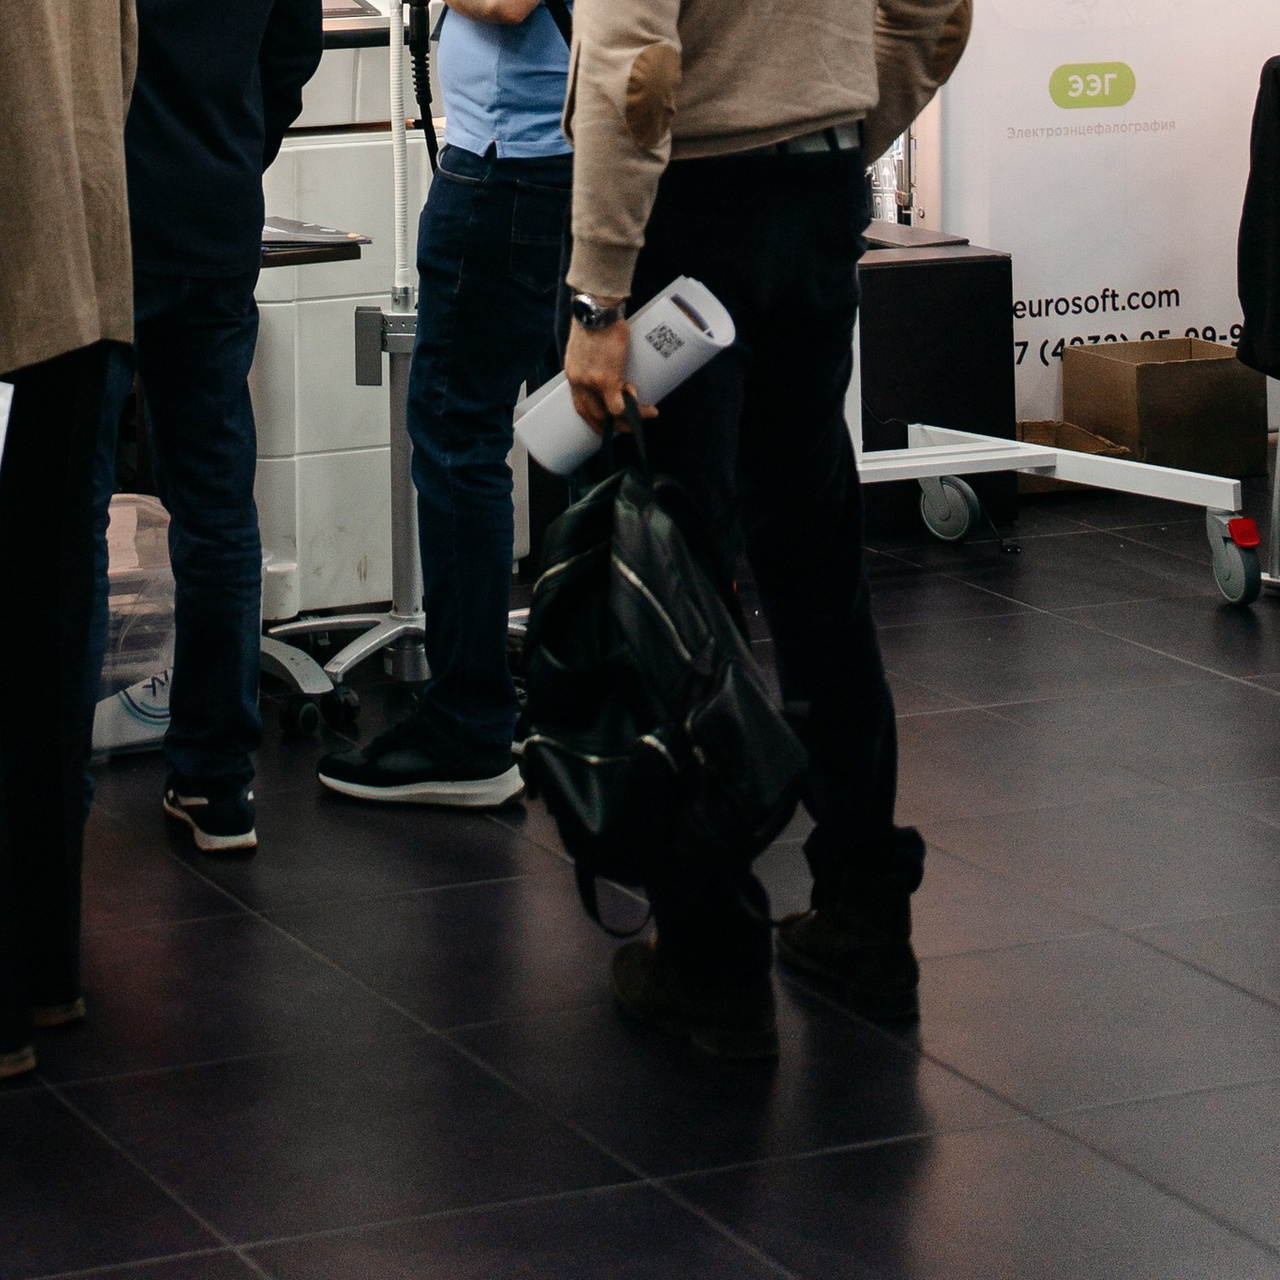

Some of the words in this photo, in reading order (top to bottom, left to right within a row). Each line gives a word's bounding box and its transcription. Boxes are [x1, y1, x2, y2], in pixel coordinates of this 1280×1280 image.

[1067, 72, 1119, 99] ЭЭГ
[1006, 120, 1176, 140] Электроэнцефалография
[1013, 288, 1180, 319] eurosoft.com
